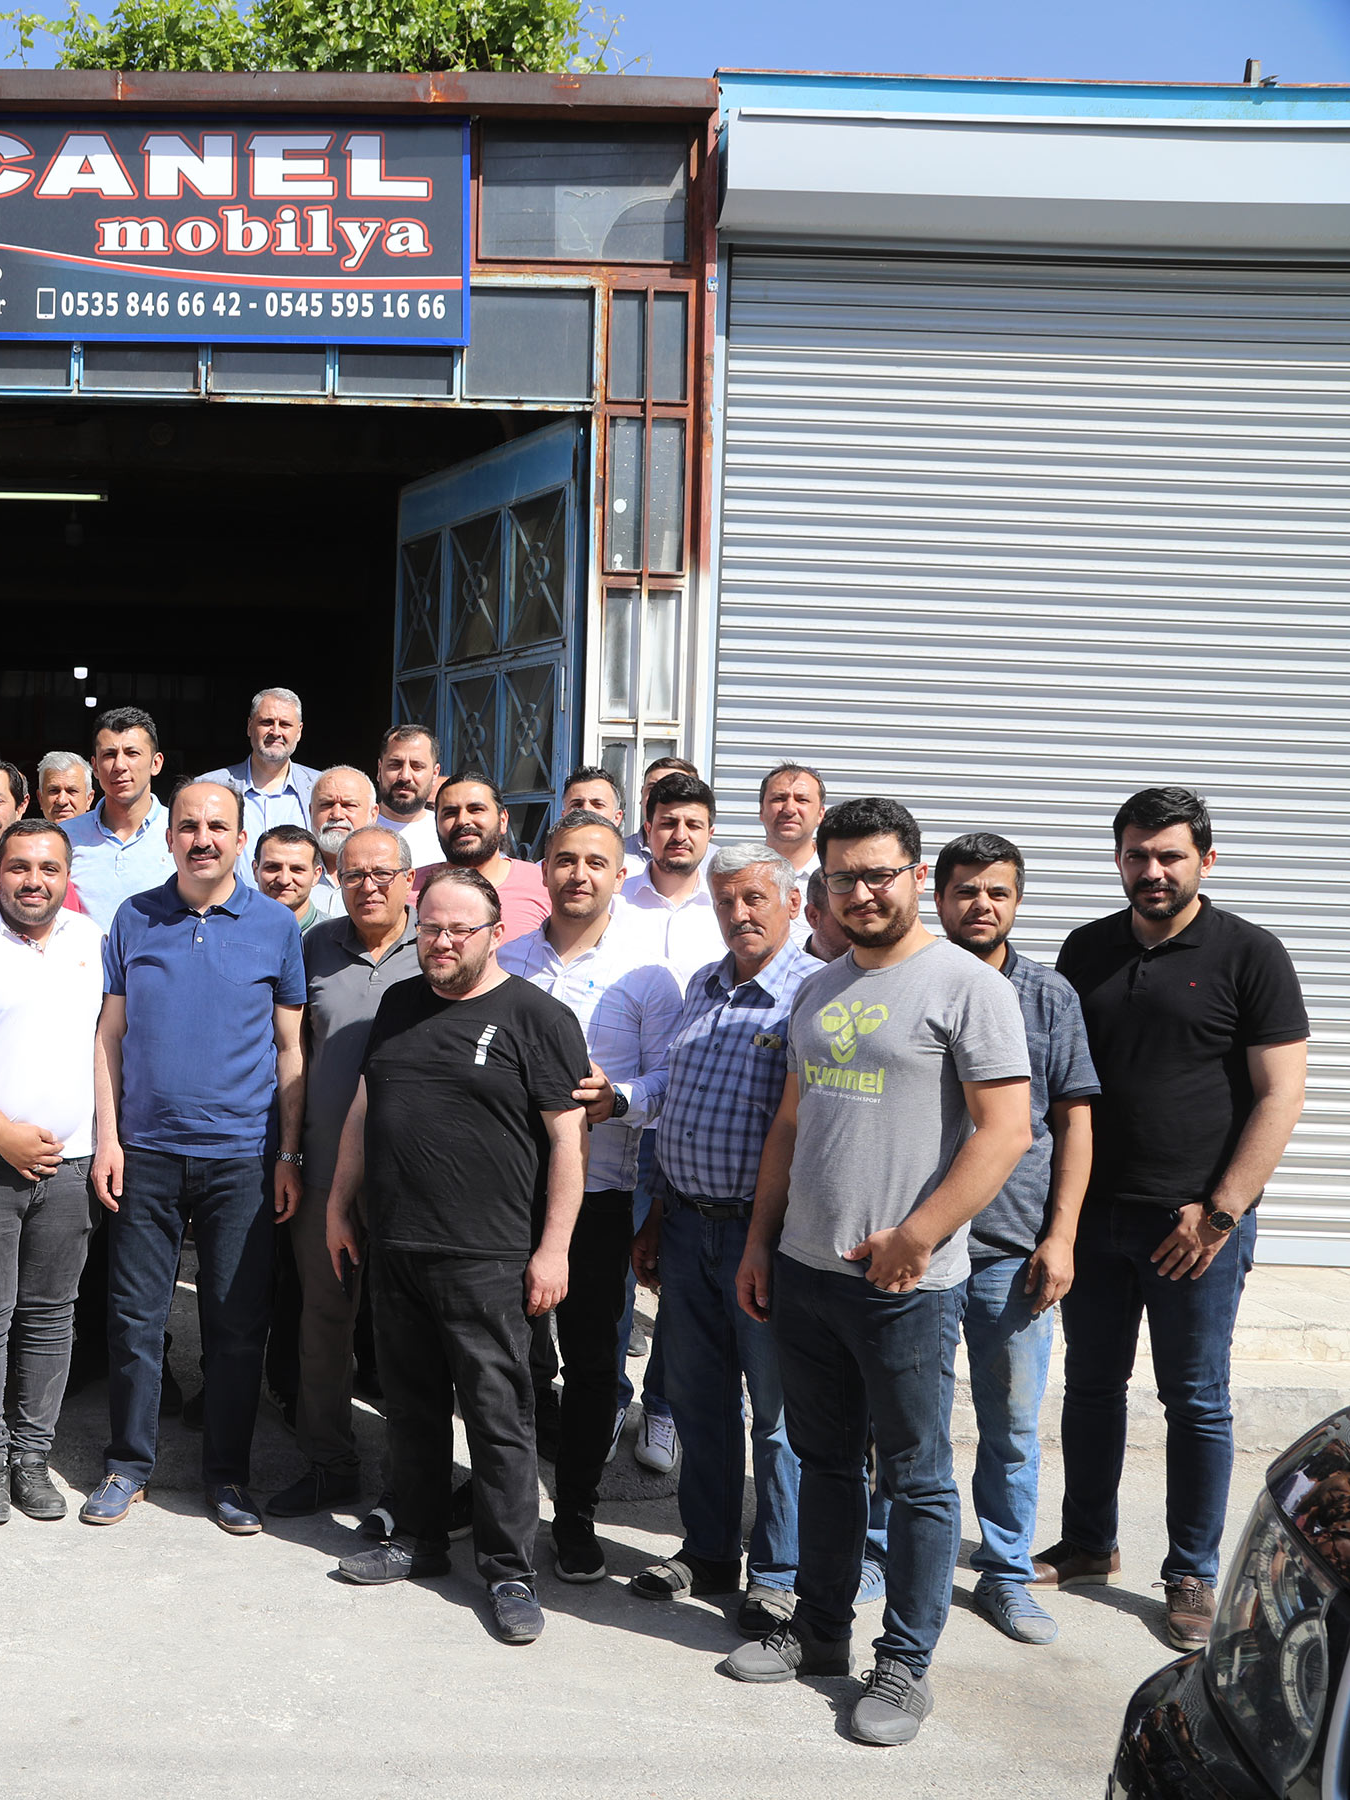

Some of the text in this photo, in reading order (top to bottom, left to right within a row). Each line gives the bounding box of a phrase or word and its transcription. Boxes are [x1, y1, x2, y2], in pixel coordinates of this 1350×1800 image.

[95, 205, 432, 271] mobilya
[61, 291, 119, 317] 0535
[126, 291, 170, 317] 846
[177, 291, 206, 317] 66
[212, 291, 241, 317] 42
[265, 291, 323, 317] 0545
[331, 292, 374, 318] 595
[382, 293, 410, 319] 16
[418, 294, 446, 320] 66
[804, 1059, 886, 1095] hummel
